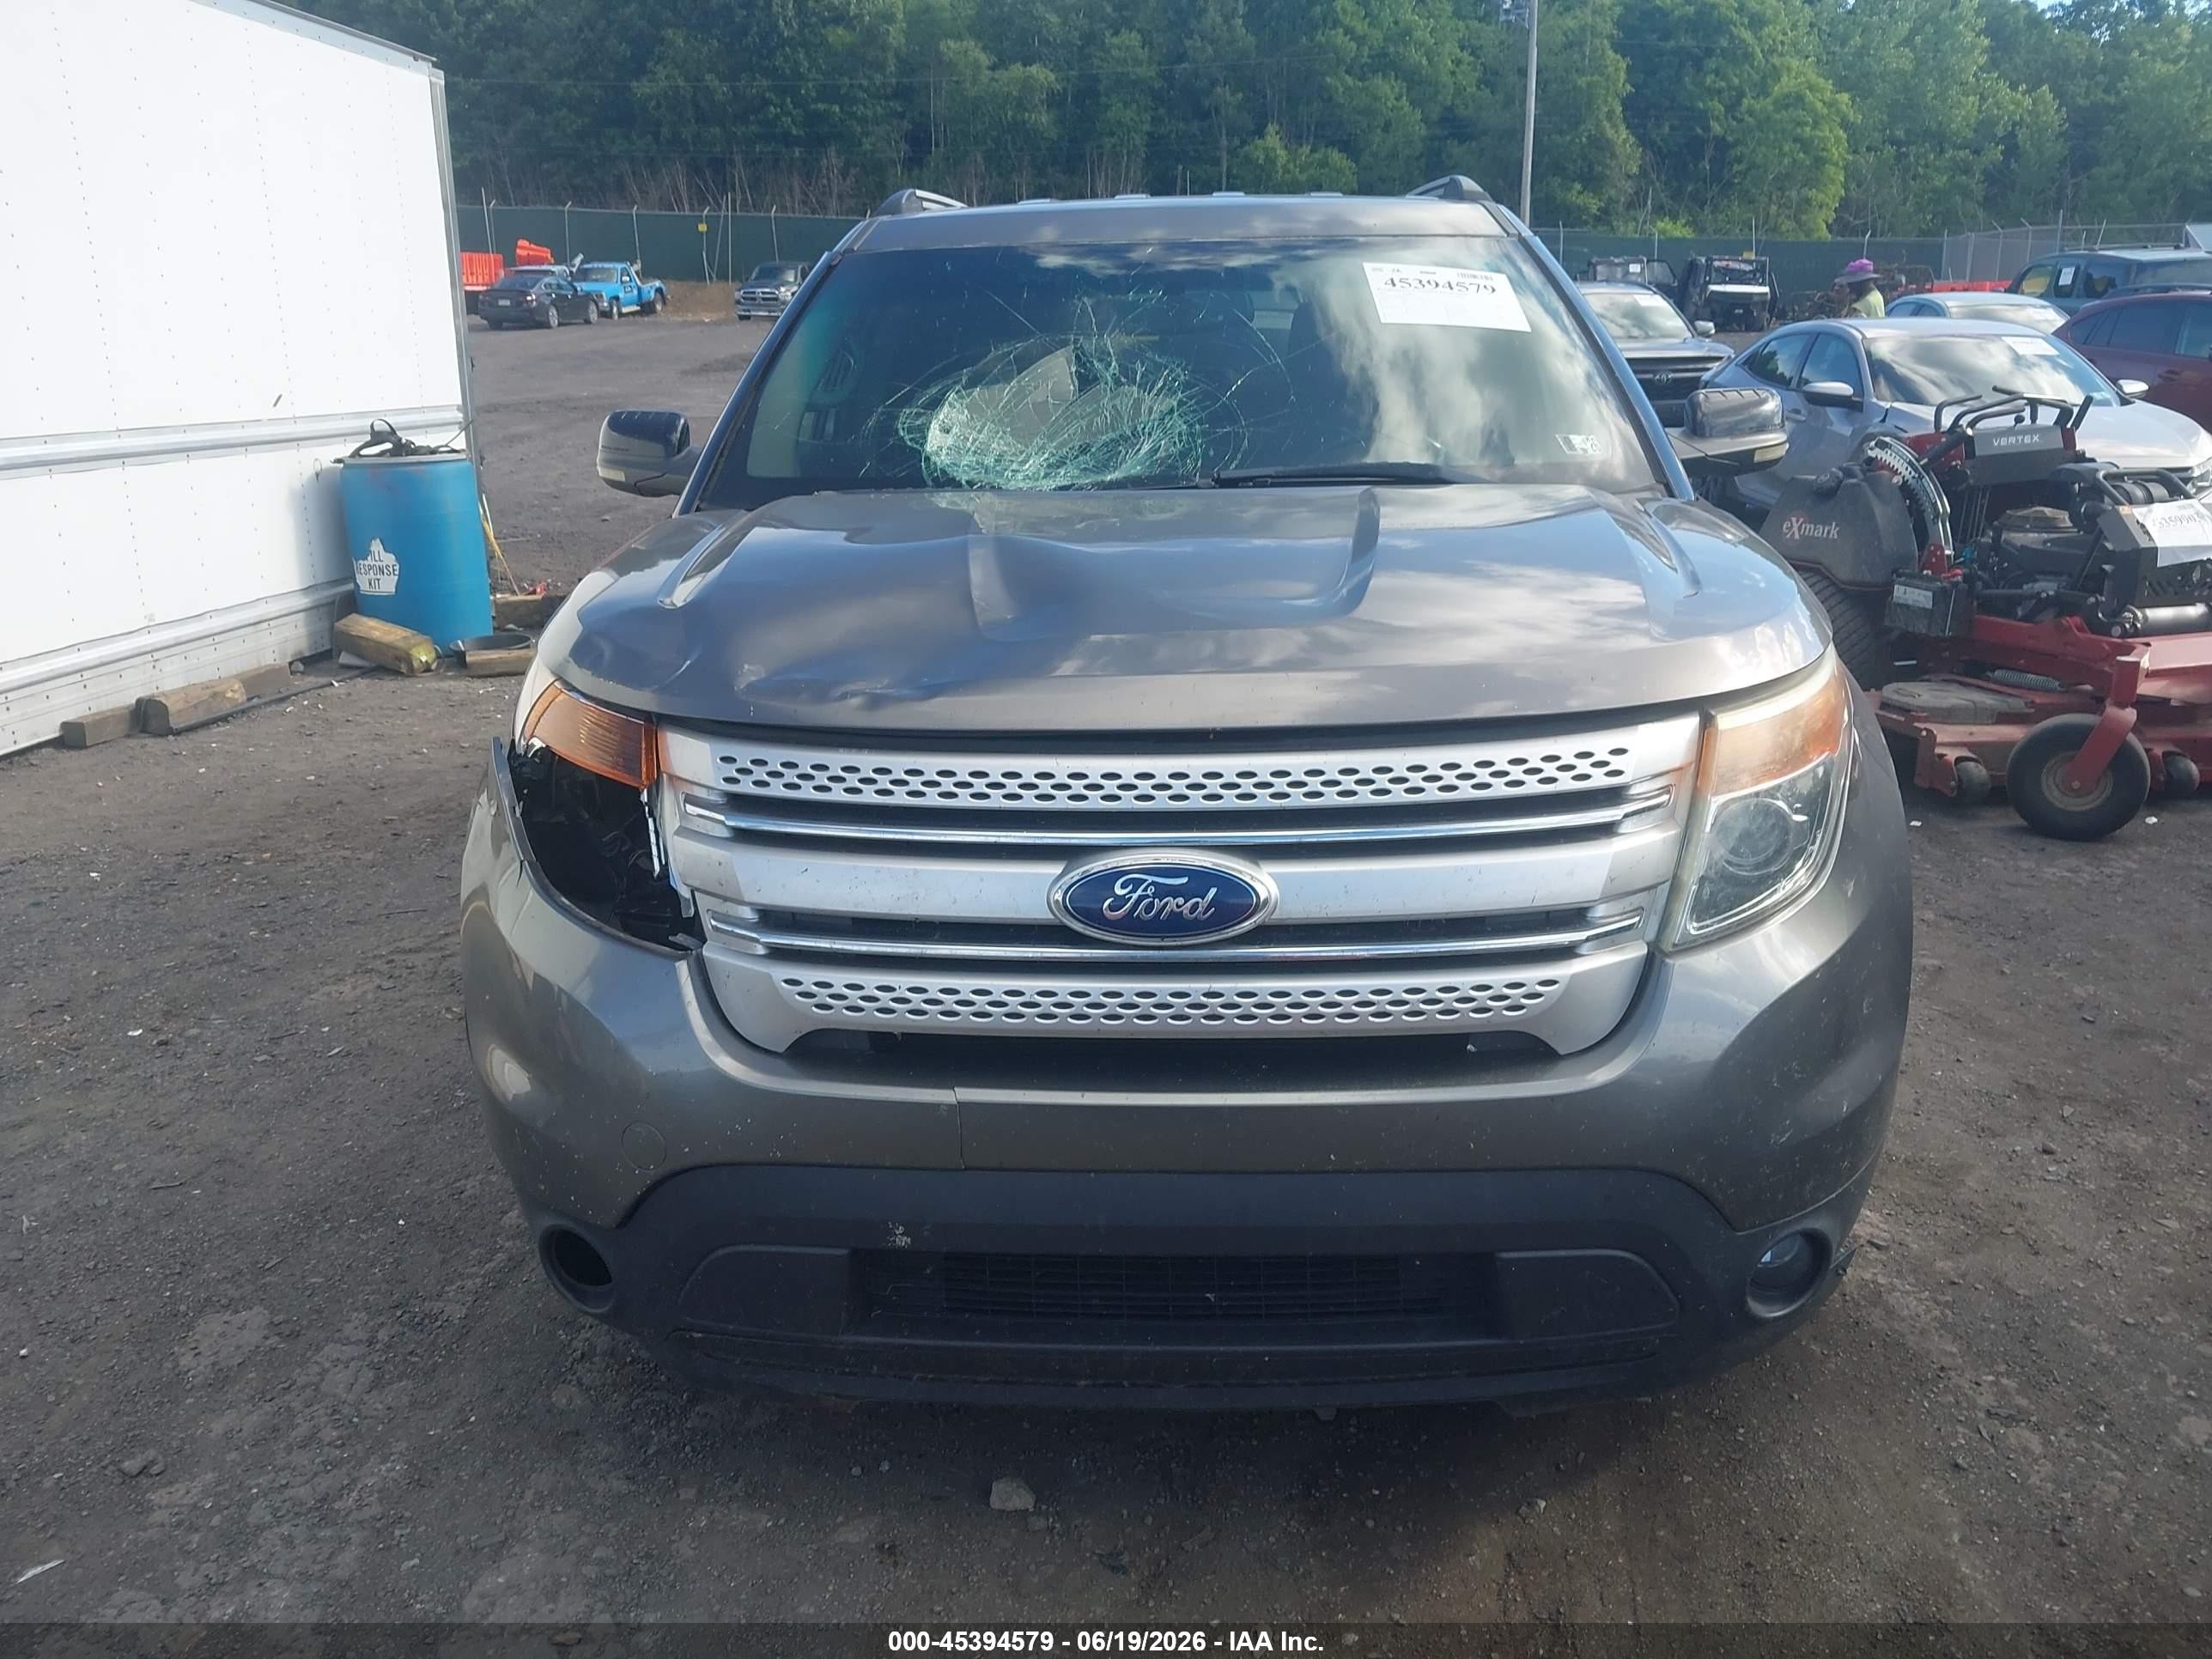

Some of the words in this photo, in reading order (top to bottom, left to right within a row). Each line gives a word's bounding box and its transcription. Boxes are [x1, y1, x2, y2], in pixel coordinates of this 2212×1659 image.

[1384, 276, 1496, 293] 45394579
[1993, 434, 2040, 447] VERTEX
[368, 577, 381, 591] KIT
[1103, 873, 1218, 921] Ford
